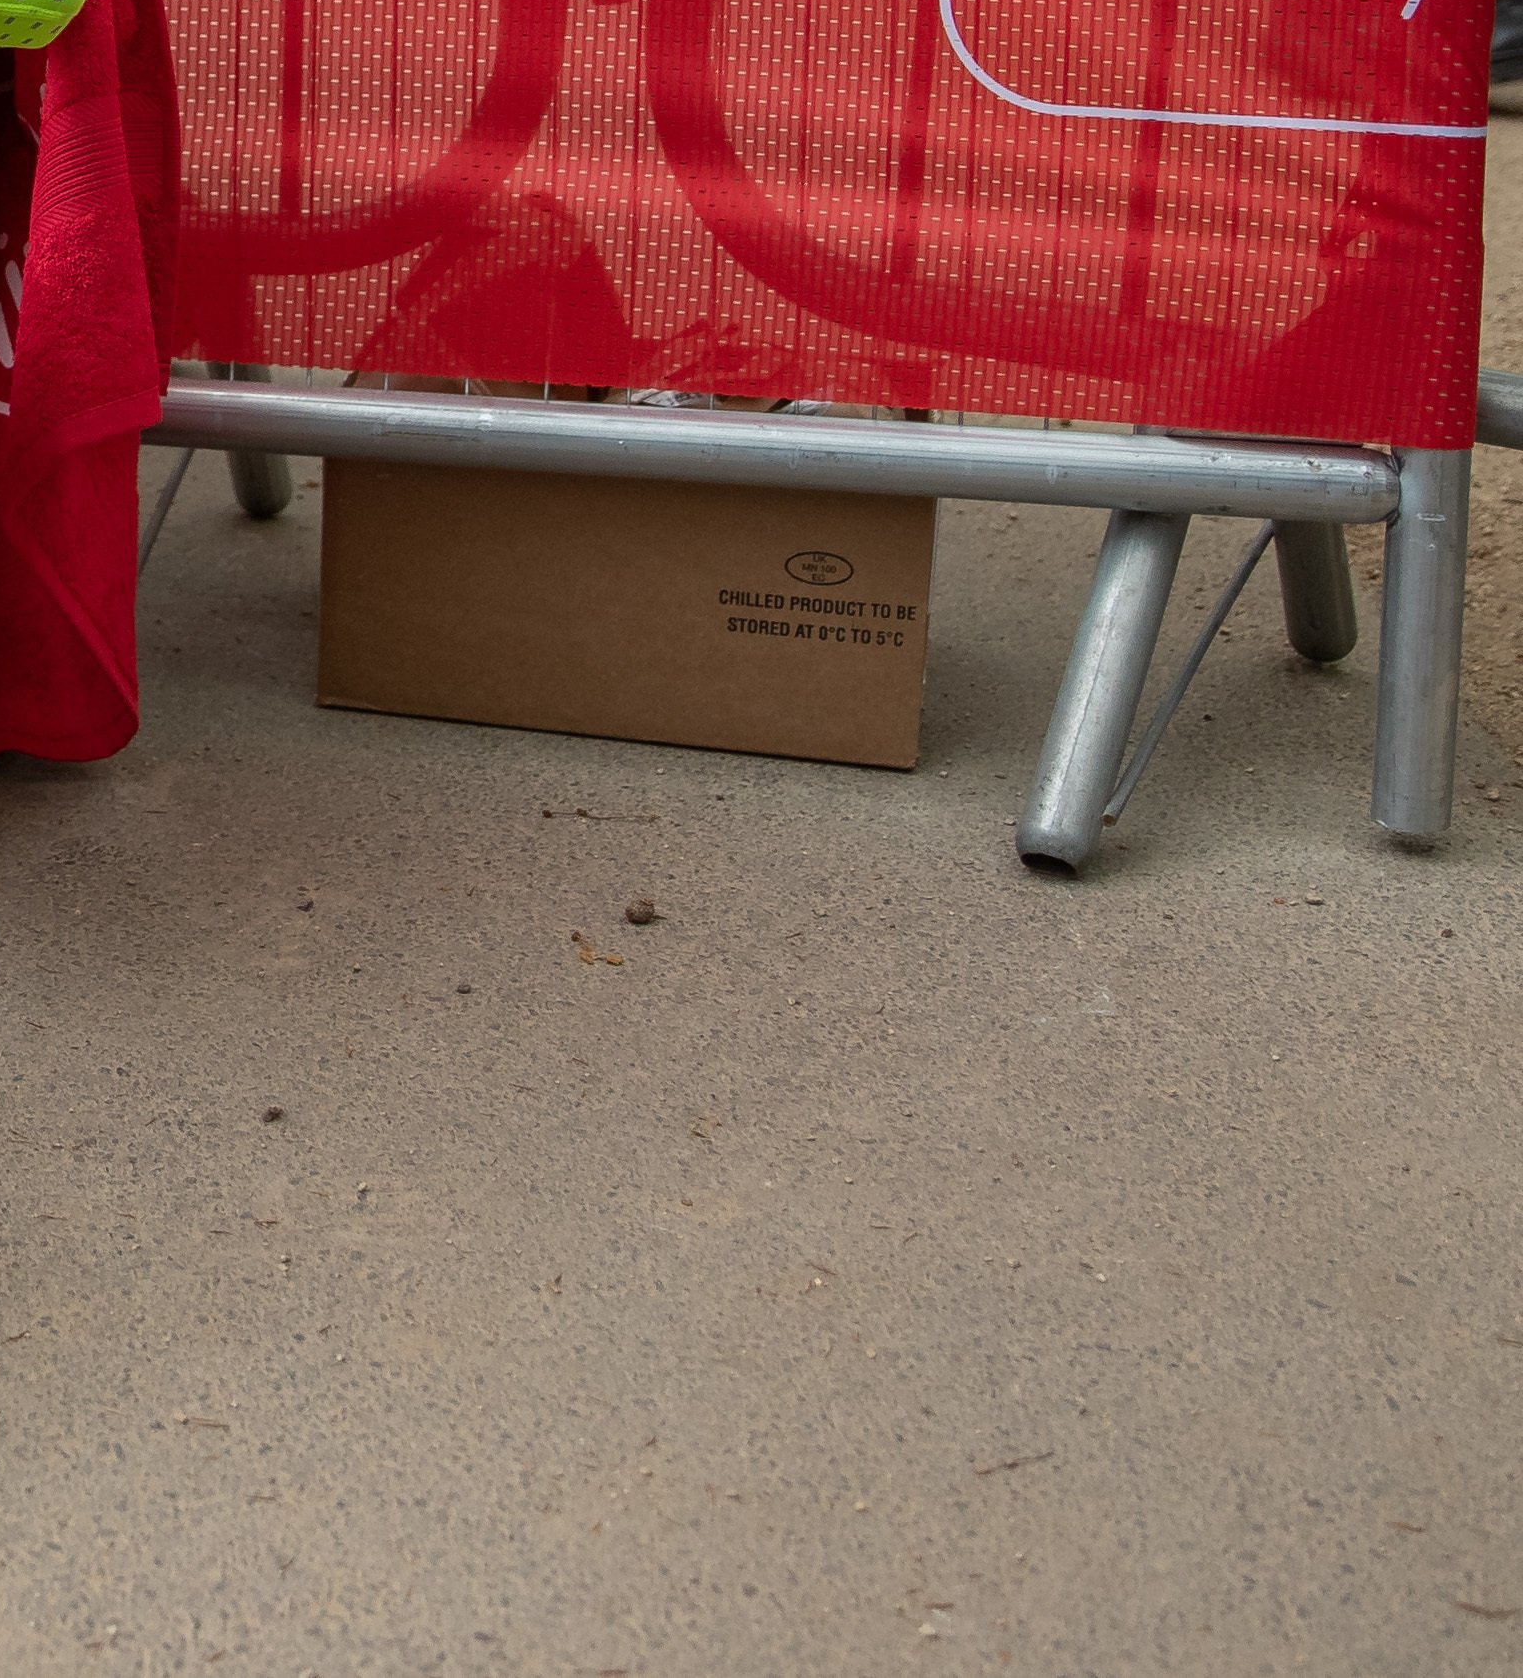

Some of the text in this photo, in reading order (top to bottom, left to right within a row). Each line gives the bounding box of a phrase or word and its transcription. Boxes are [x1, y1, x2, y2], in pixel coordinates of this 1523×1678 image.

[718, 589, 917, 621] CHILLED PRODUCT TO BE
[727, 616, 905, 647] STORED AT 0°C TO 5°C
